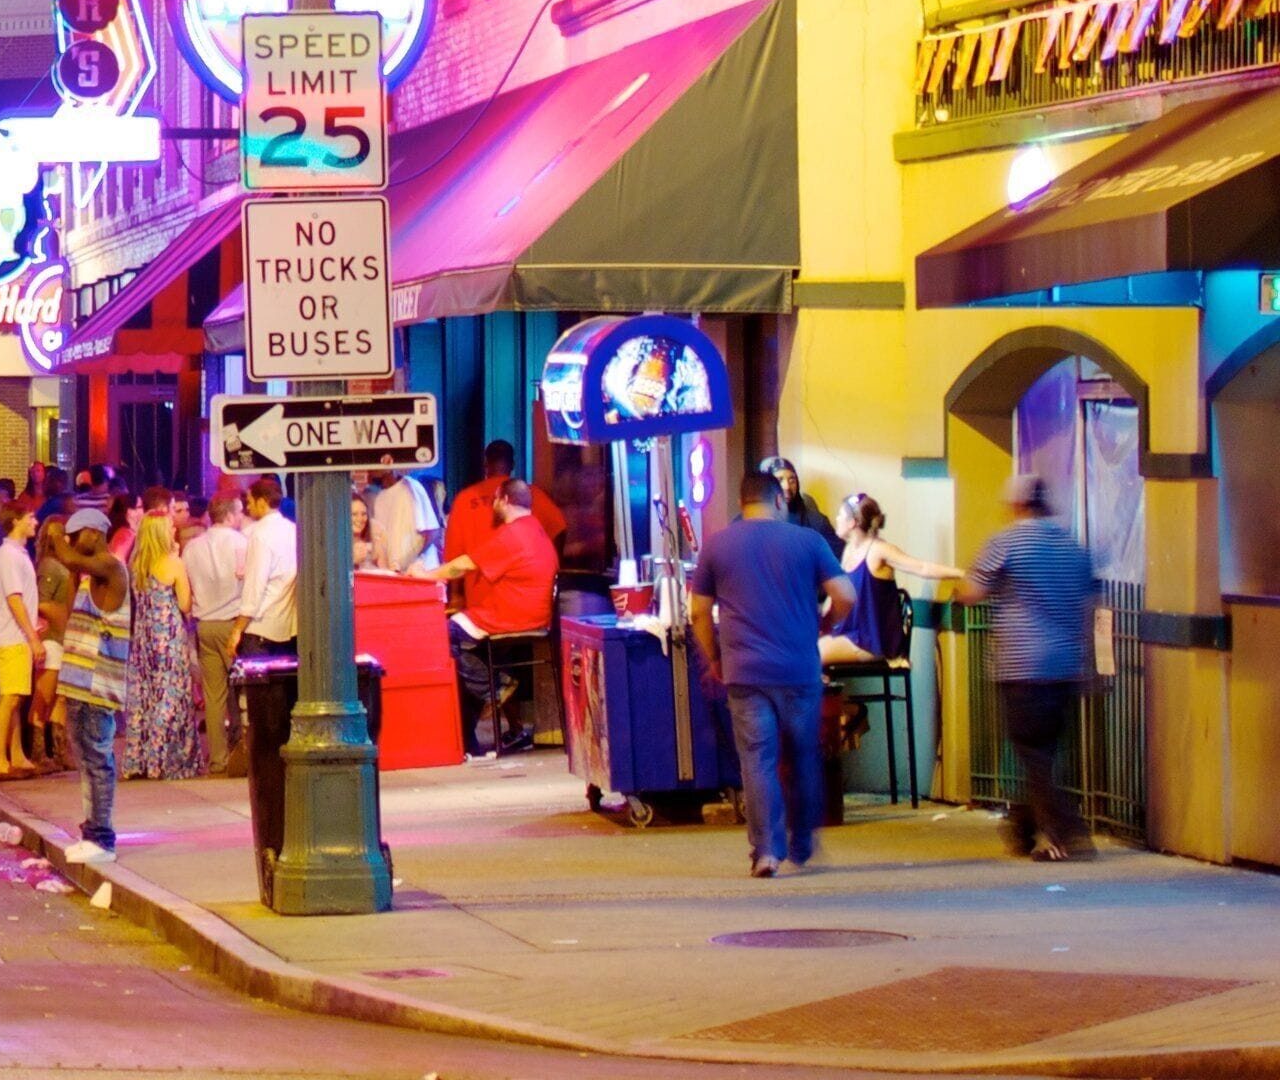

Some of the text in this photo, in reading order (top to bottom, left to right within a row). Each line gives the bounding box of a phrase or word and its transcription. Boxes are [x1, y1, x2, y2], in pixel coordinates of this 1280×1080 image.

[254, 32, 371, 60] SPEED
[267, 70, 358, 96] LIMIT
[258, 106, 371, 169] 25
[295, 220, 337, 247] NO
[255, 255, 380, 285] TRUCKS
[298, 295, 339, 321] OR
[393, 284, 423, 322] TREET
[268, 329, 373, 357] BUSES
[285, 417, 411, 447] ONE WAY
